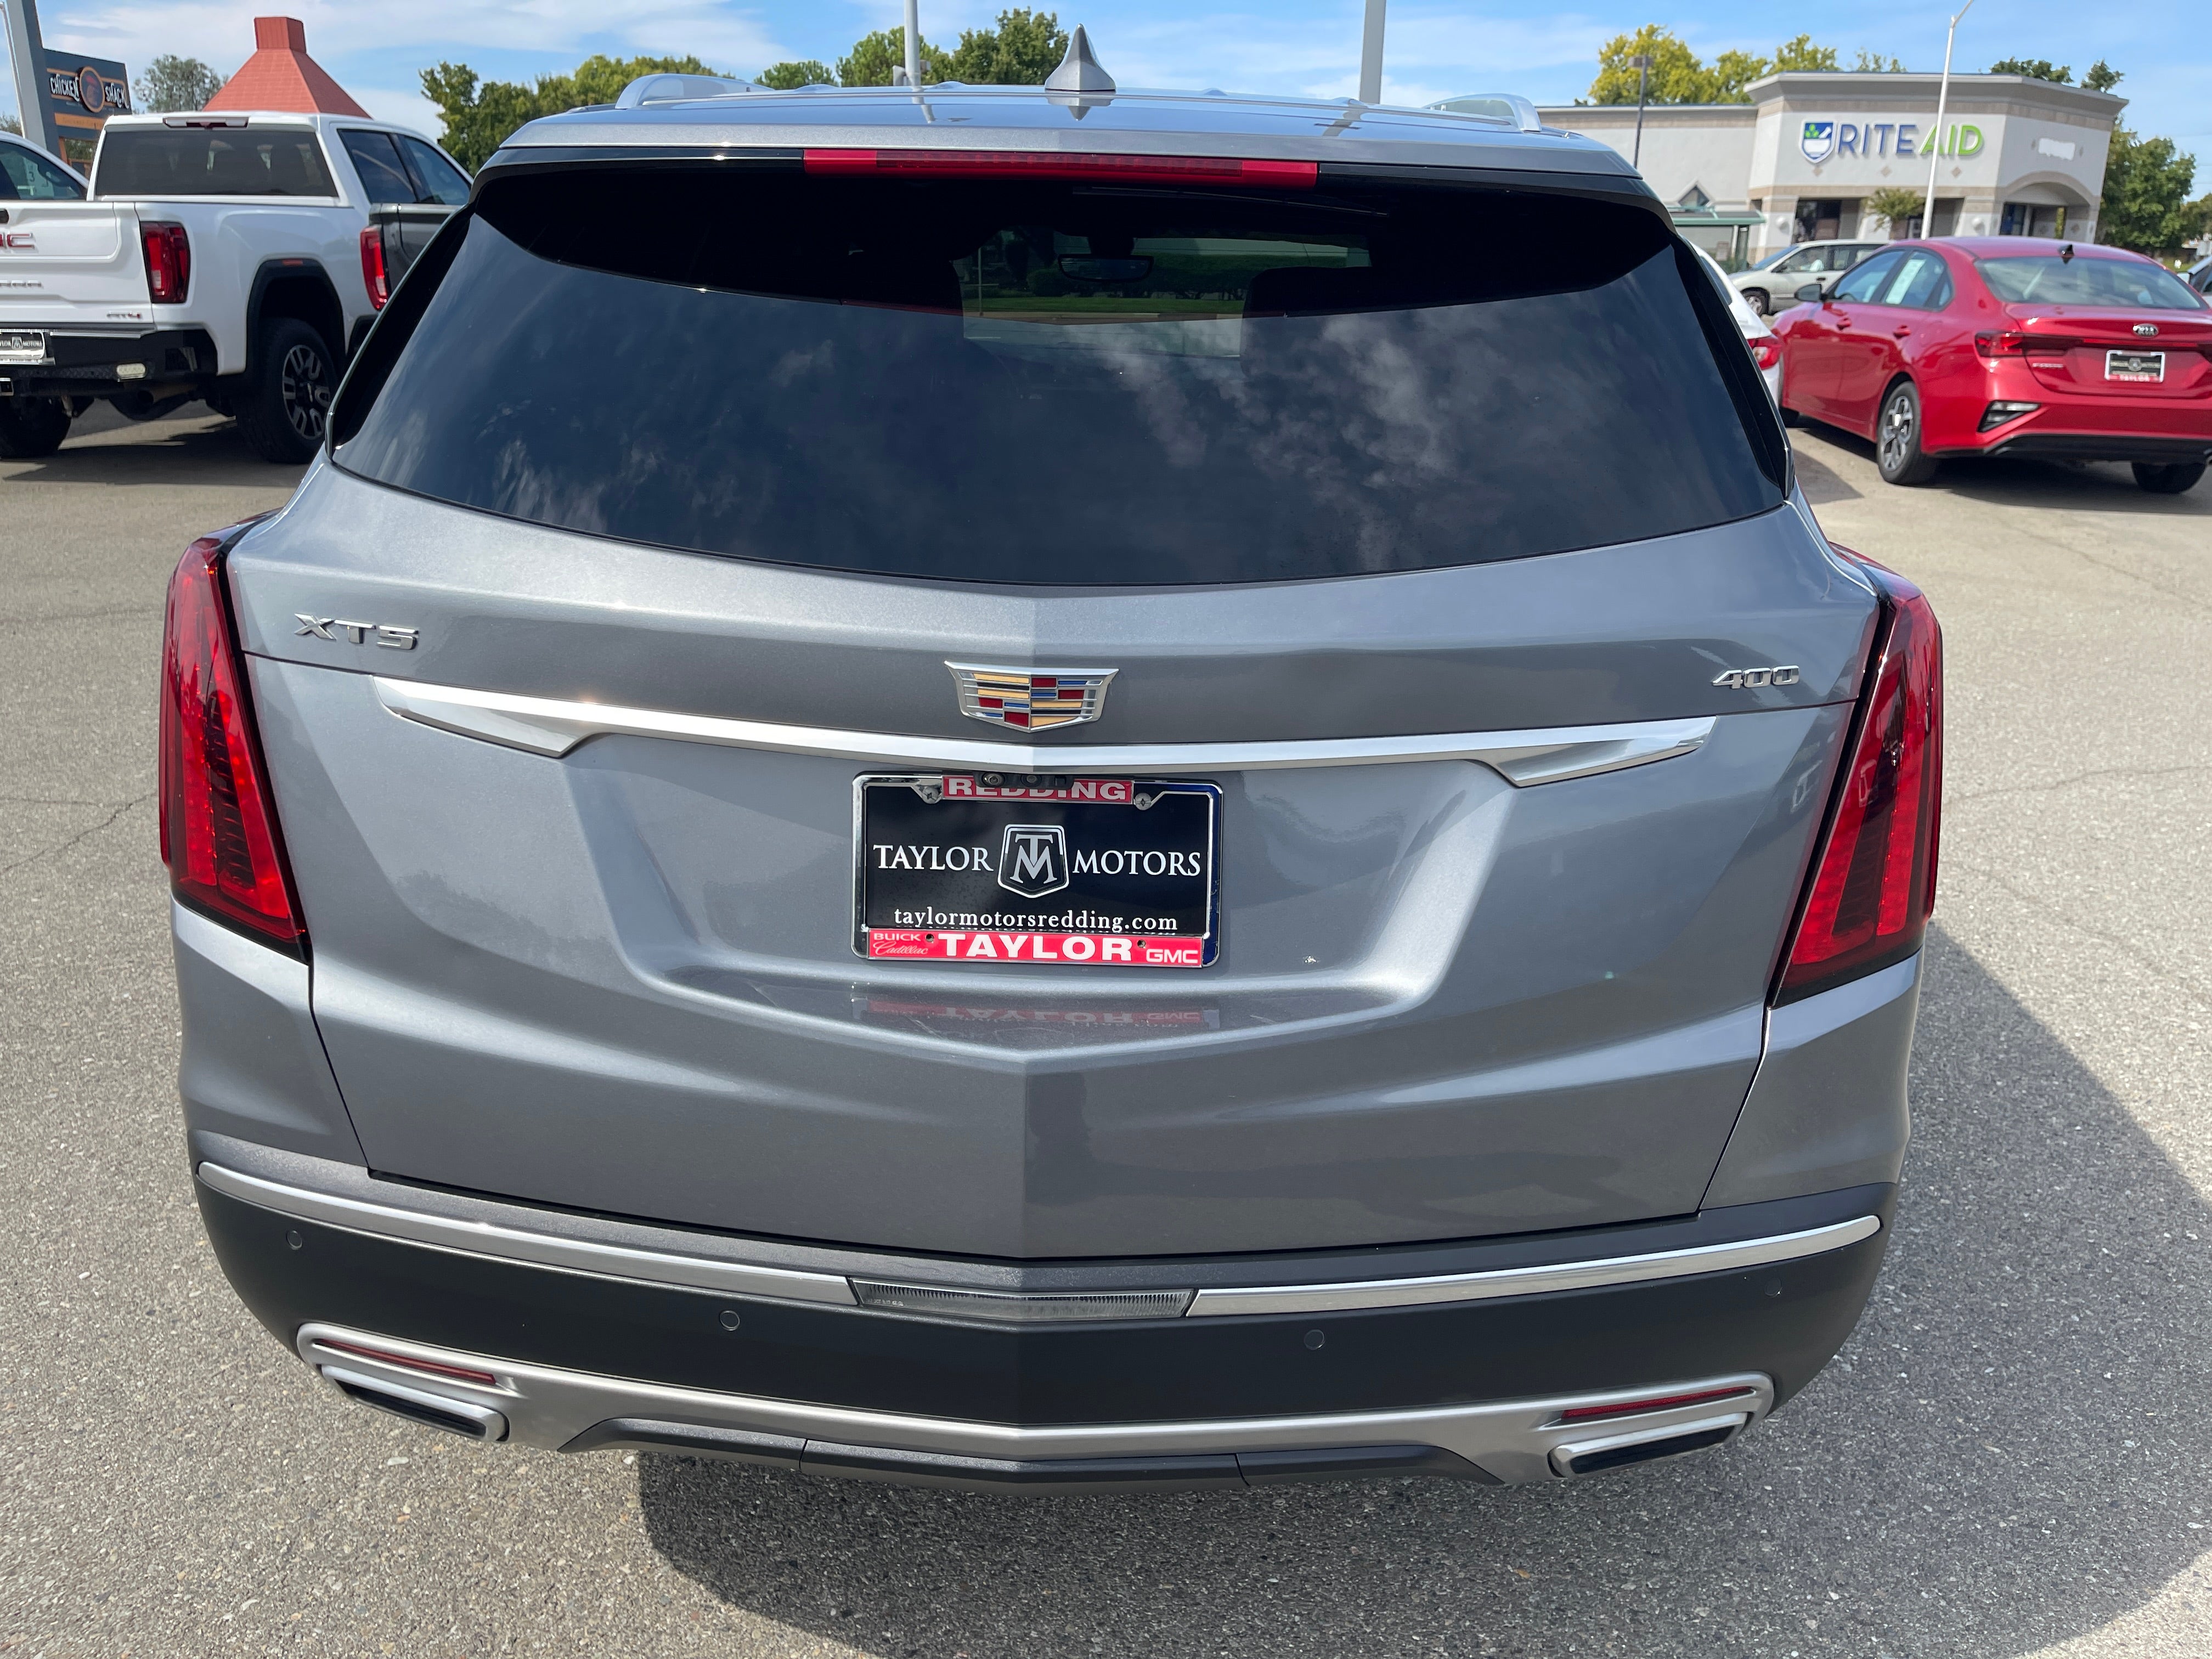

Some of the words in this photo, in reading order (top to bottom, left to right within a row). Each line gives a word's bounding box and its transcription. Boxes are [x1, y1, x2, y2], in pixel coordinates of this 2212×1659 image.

[50, 74, 80, 102] CHICKEN
[105, 83, 129, 109] SHACK
[1838, 124, 1917, 154] RITE
[1920, 124, 1983, 156] AID
[294, 613, 420, 650] XT5
[1711, 665, 1799, 689] 400
[873, 844, 994, 872] TAYLOR
[1072, 849, 1201, 877] MOTORS
[894, 906, 1178, 933] taylormotorsredding.com
[873, 933, 922, 941] BUICK
[873, 940, 929, 955] Cadillac
[938, 933, 1133, 962] TAYLOR
[1146, 949, 1198, 964] GMC
